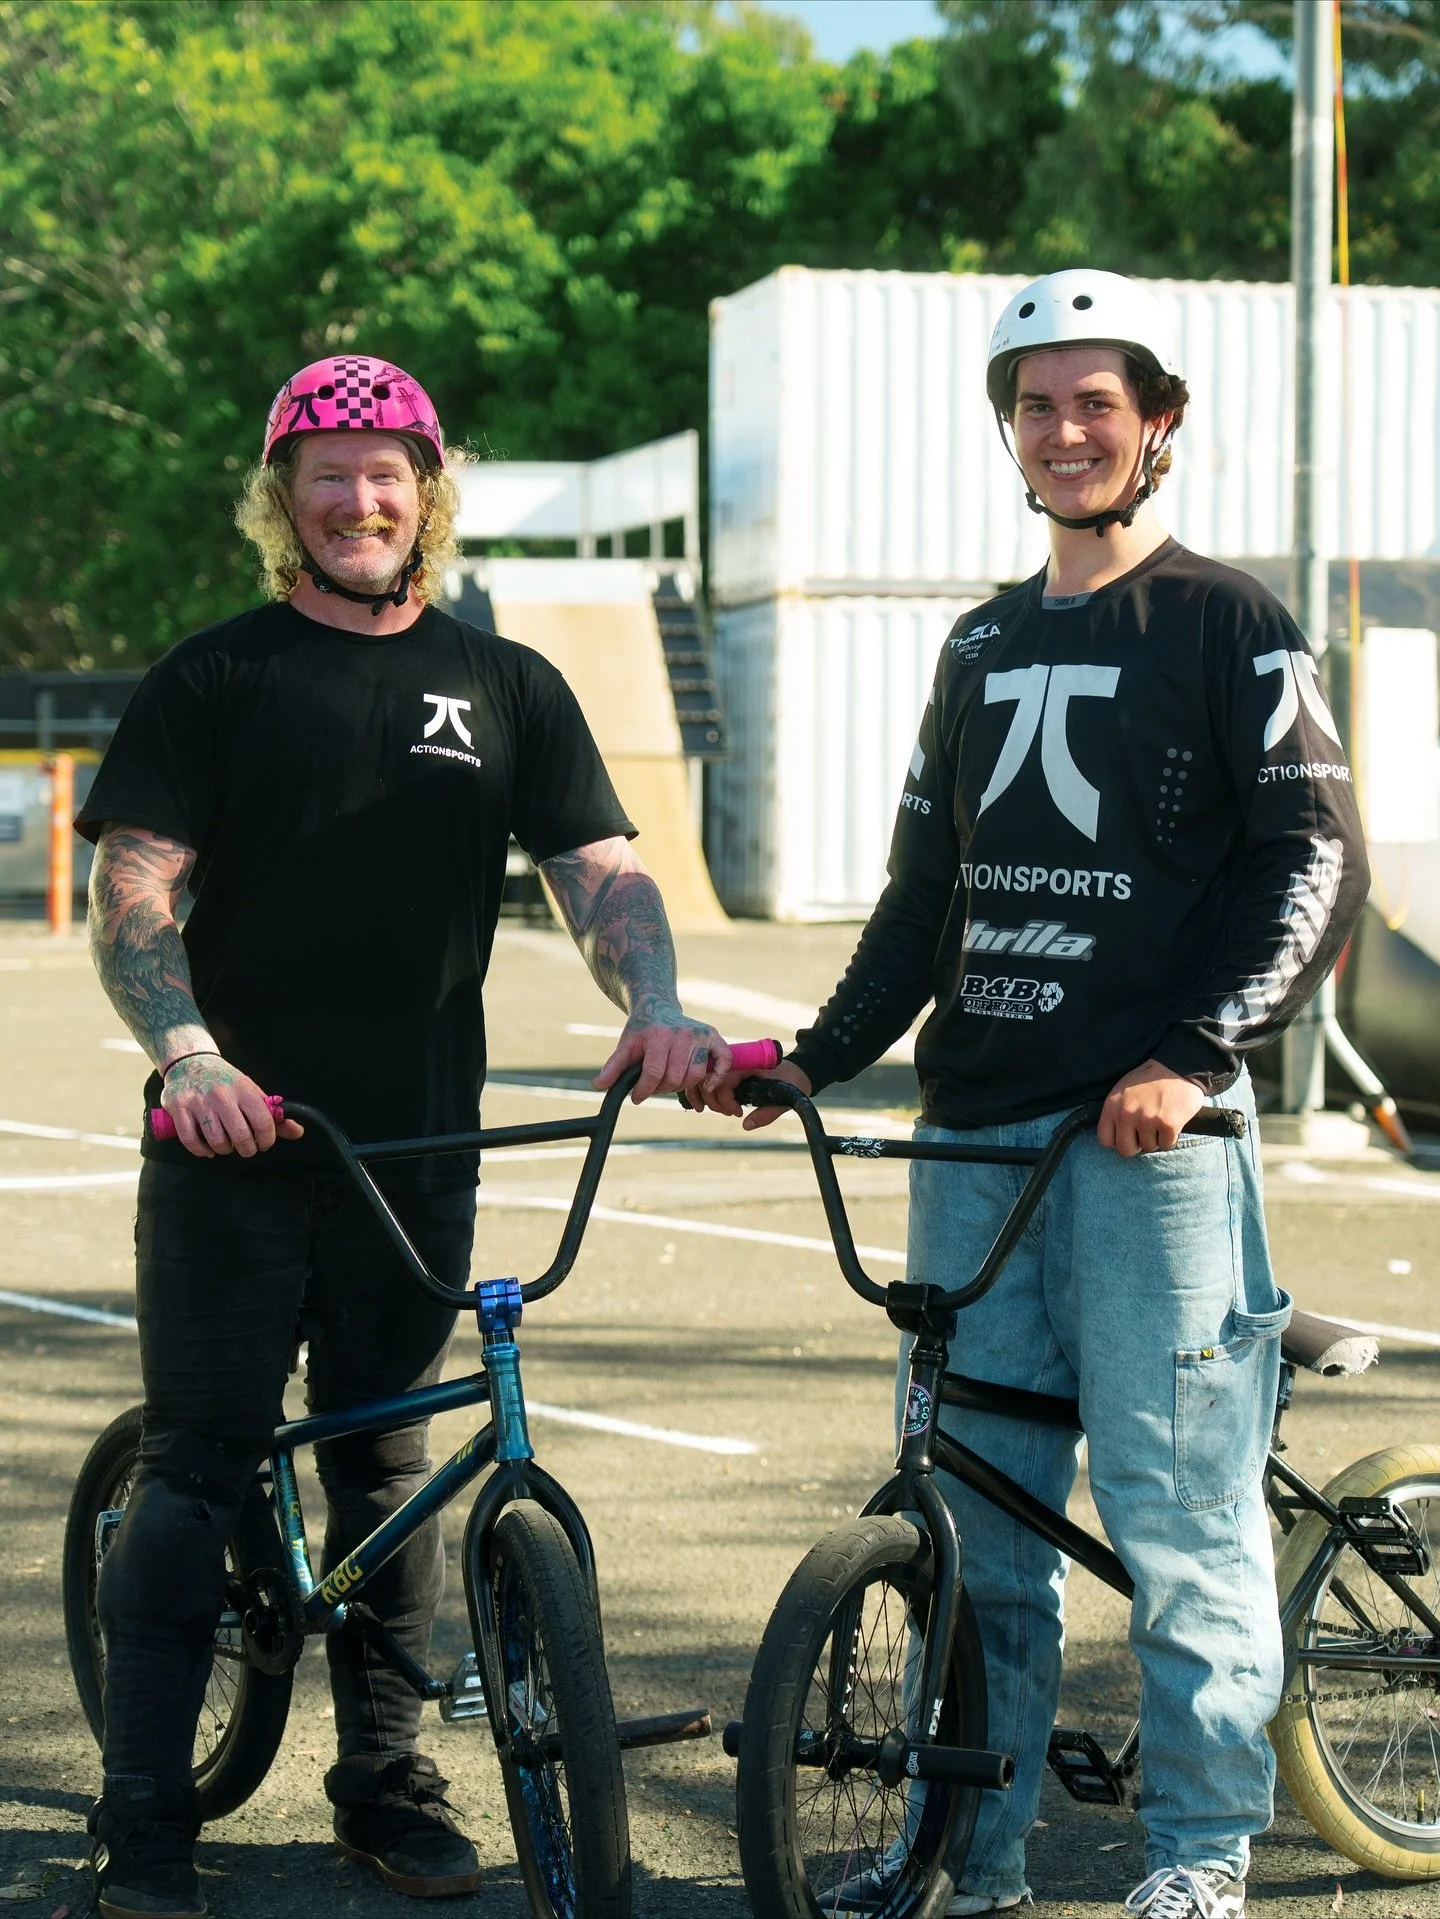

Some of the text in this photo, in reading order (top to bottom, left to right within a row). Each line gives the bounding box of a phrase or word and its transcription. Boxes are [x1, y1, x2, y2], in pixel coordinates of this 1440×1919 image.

[410, 745, 482, 768] ACTIONSPORTS
[1257, 762, 1353, 784] CTIONSPOR
[955, 863, 1132, 901] TIONSPORTS
[961, 920, 1094, 959] hrila
[960, 974, 1041, 1002] B&B
[963, 997, 990, 1011] OFF
[991, 1000, 1034, 1016] ROAD
[910, 1387, 929, 1405] BIKE
